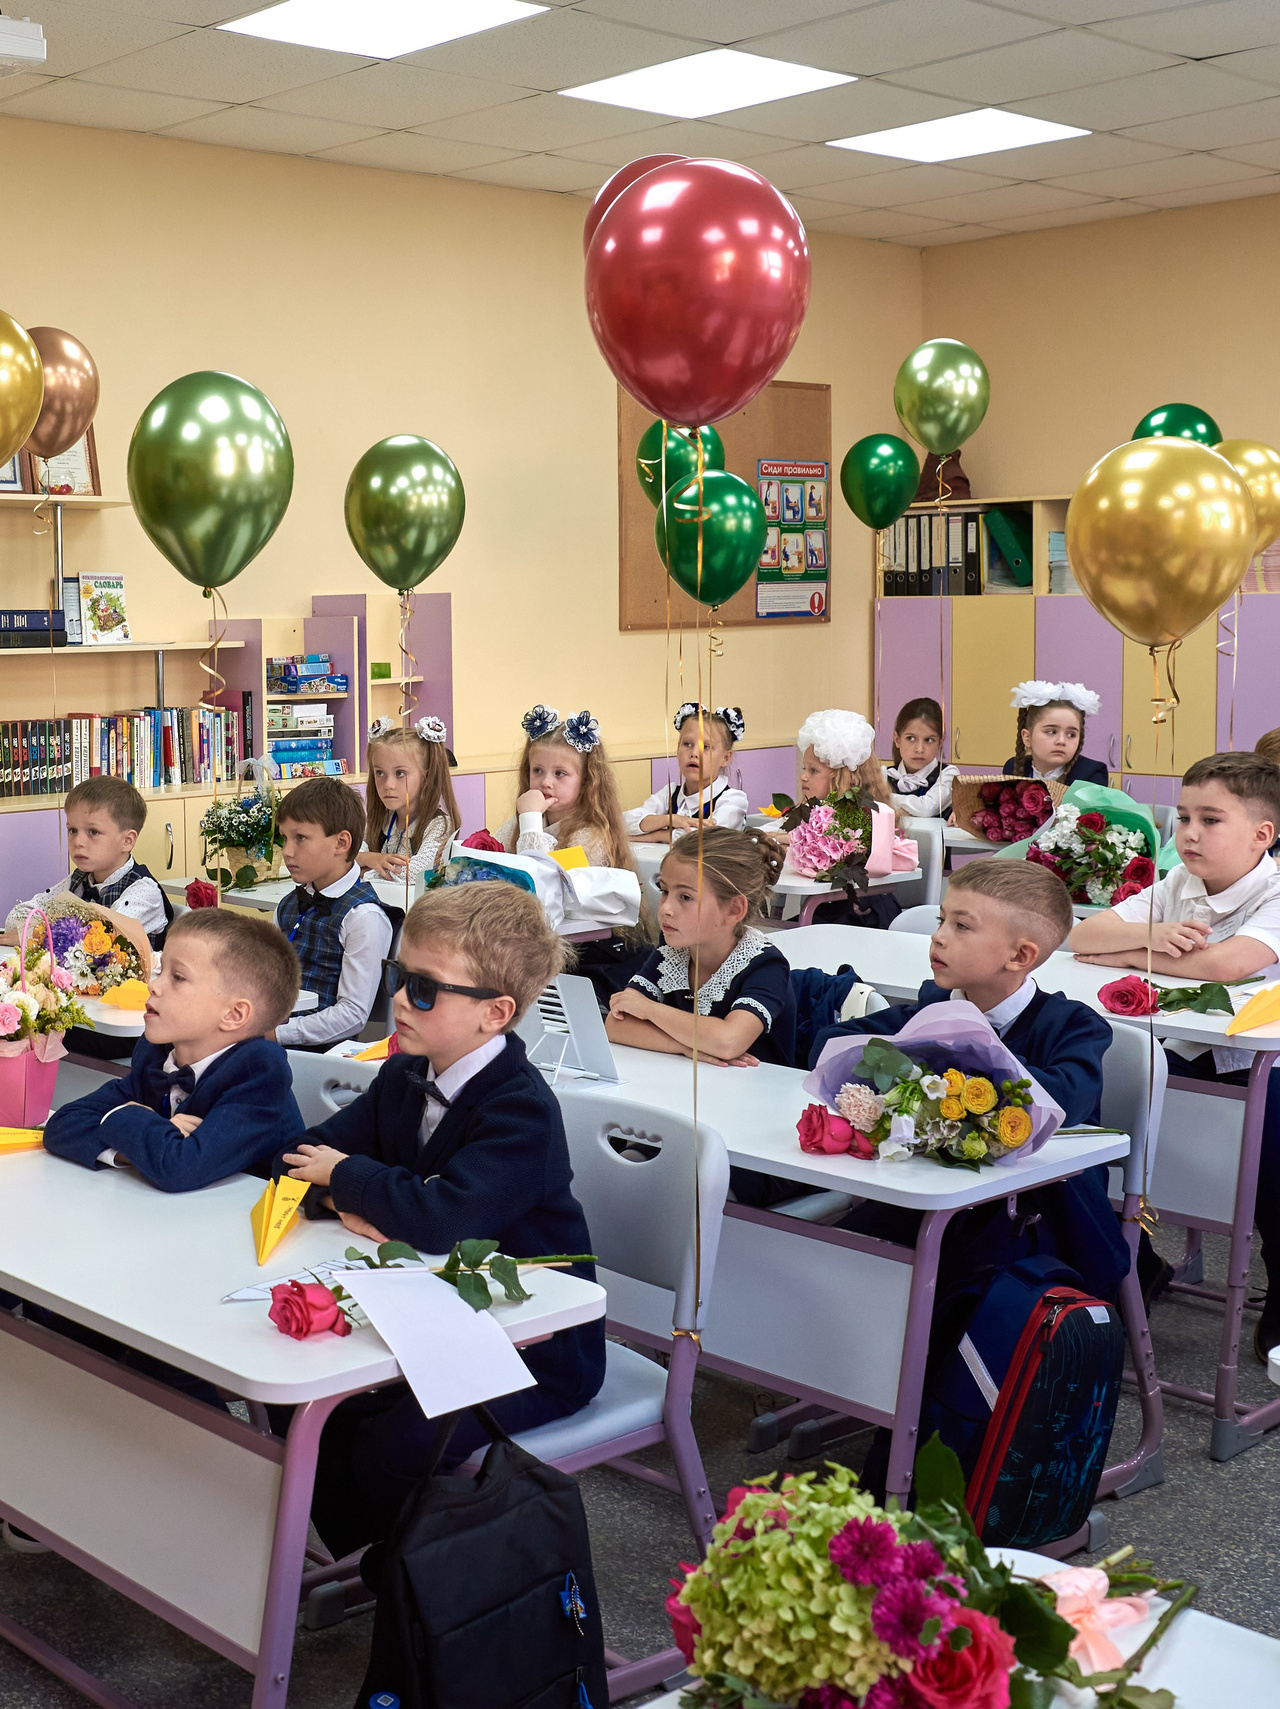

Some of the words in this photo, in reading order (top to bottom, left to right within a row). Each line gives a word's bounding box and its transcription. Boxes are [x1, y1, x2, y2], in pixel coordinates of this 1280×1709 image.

[762, 464, 782, 475] Сиди
[784, 466, 822, 475] правильно
[94, 581, 124, 589] СЛОВАРЬ
